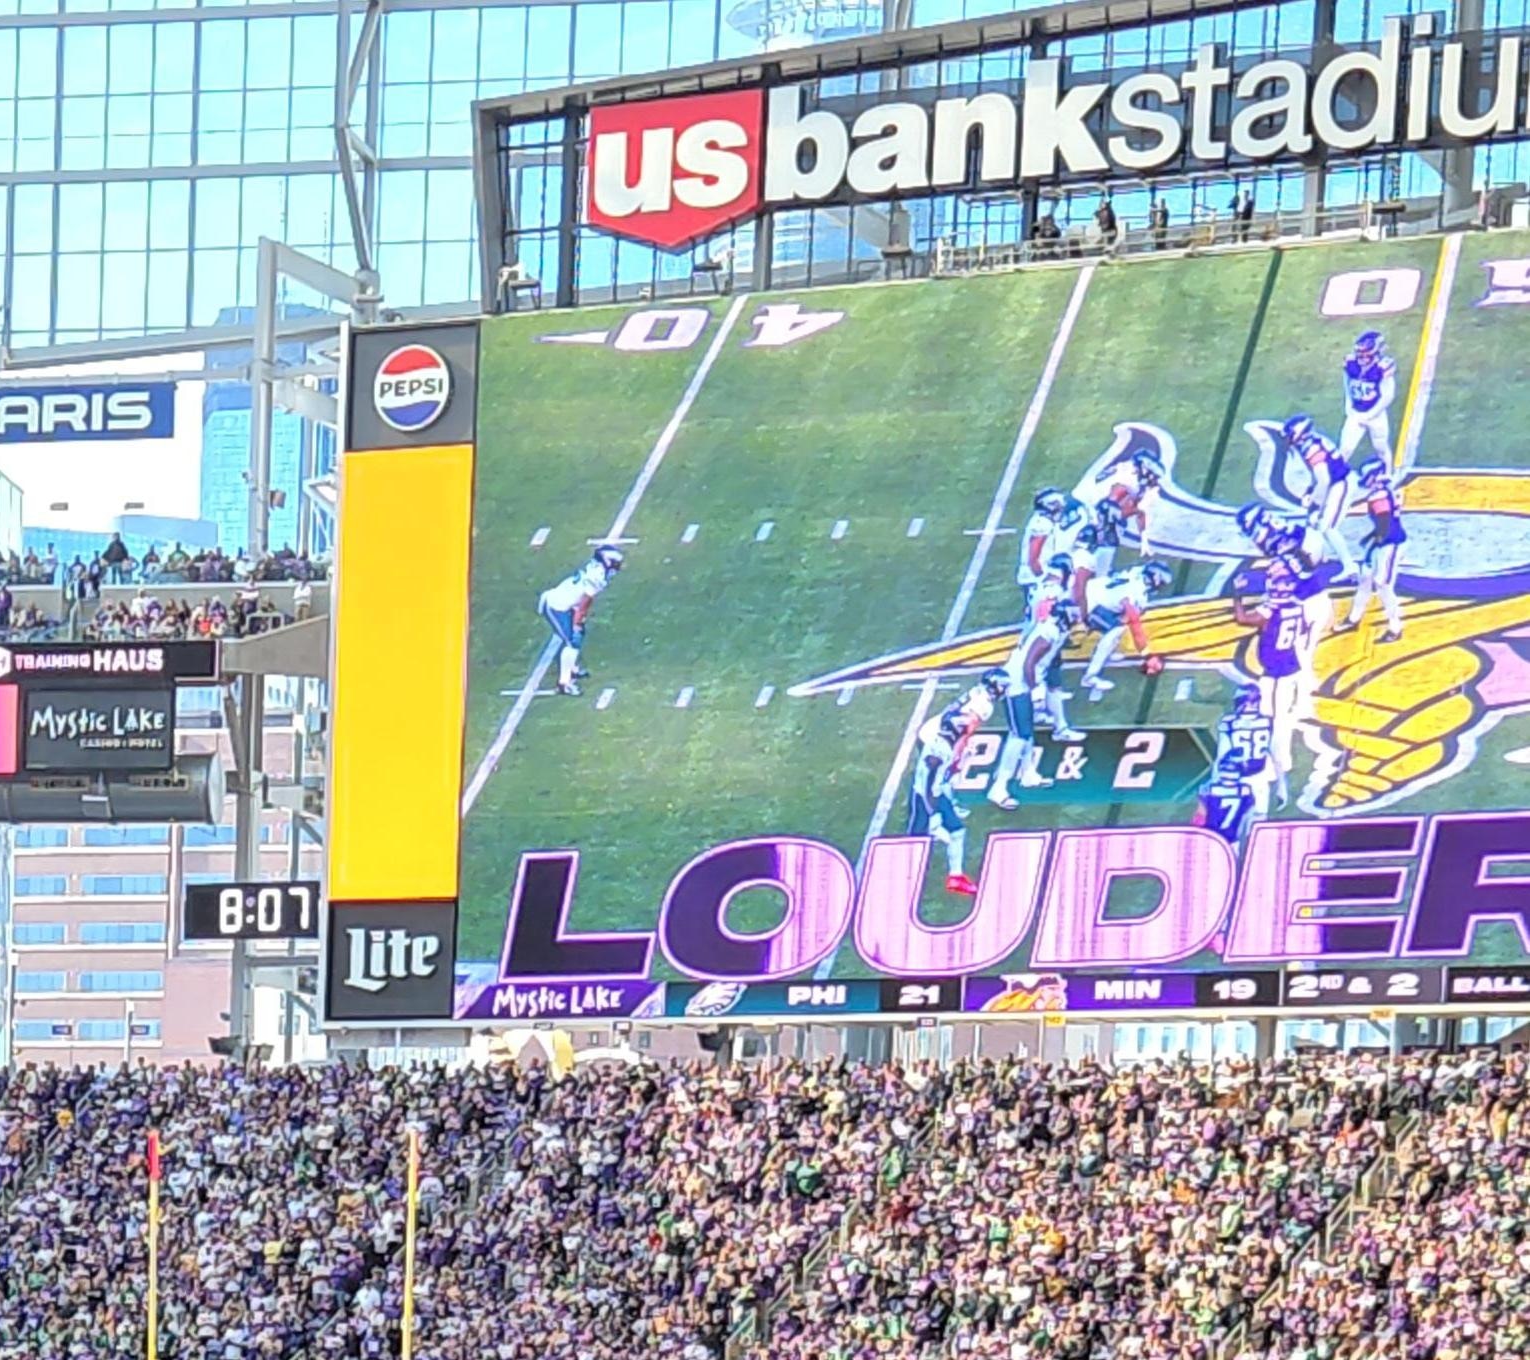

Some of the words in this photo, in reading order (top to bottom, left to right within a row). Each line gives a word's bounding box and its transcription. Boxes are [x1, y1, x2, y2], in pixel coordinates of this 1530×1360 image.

[594, 116, 749, 219] us
[1107, 13, 1530, 169] stadiu
[379, 378, 444, 399] PEPSI
[92, 648, 164, 673] HAUS
[1113, 731, 1166, 789] 2
[219, 886, 311, 934] 8:07
[343, 926, 441, 992] Lite
[787, 985, 848, 1007] PHI
[898, 984, 940, 1006] 21
[1094, 978, 1164, 1002] MIN
[1212, 978, 1257, 1001] 19
[1347, 976, 1372, 995] &
[1386, 972, 1421, 997] 2
